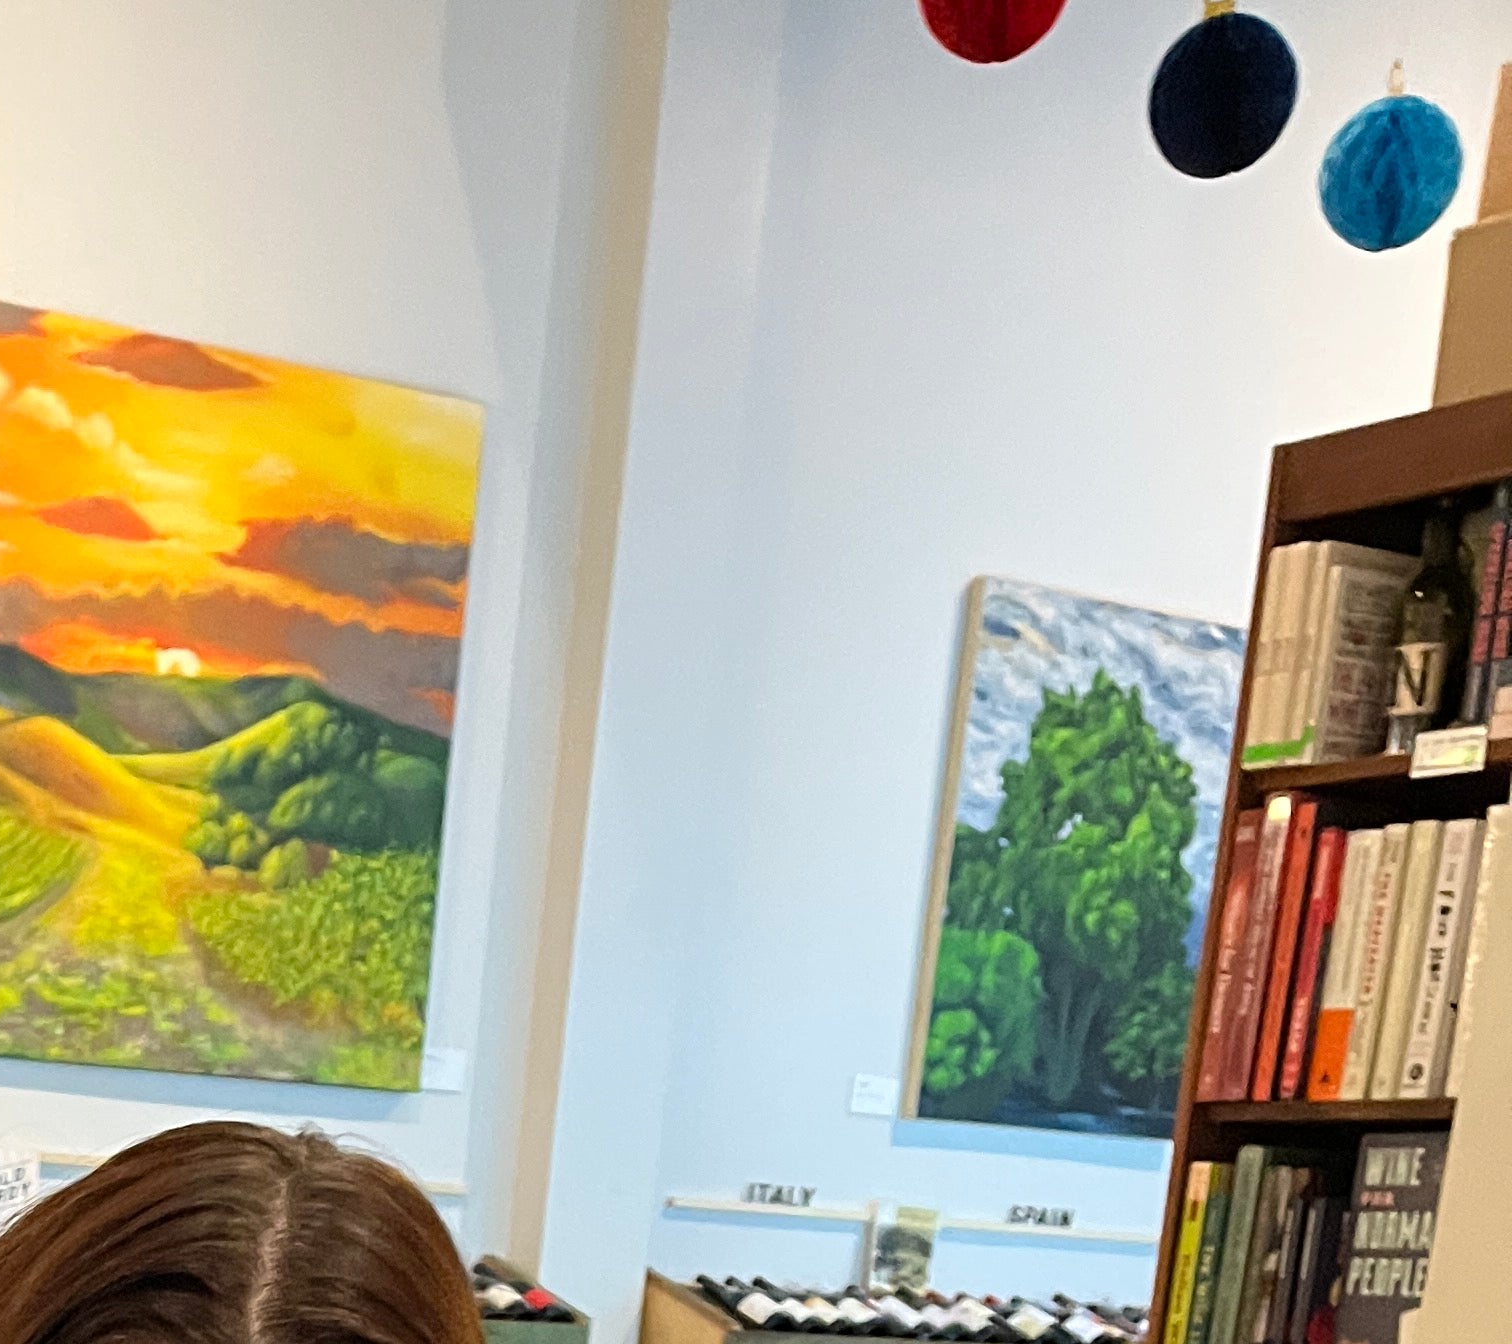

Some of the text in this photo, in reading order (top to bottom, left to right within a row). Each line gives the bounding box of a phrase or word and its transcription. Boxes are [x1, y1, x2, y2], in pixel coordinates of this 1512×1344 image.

[1365, 1146, 1426, 1186] WINE
[741, 1182, 817, 1207] ITALY
[1006, 1204, 1076, 1228] SPAIN
